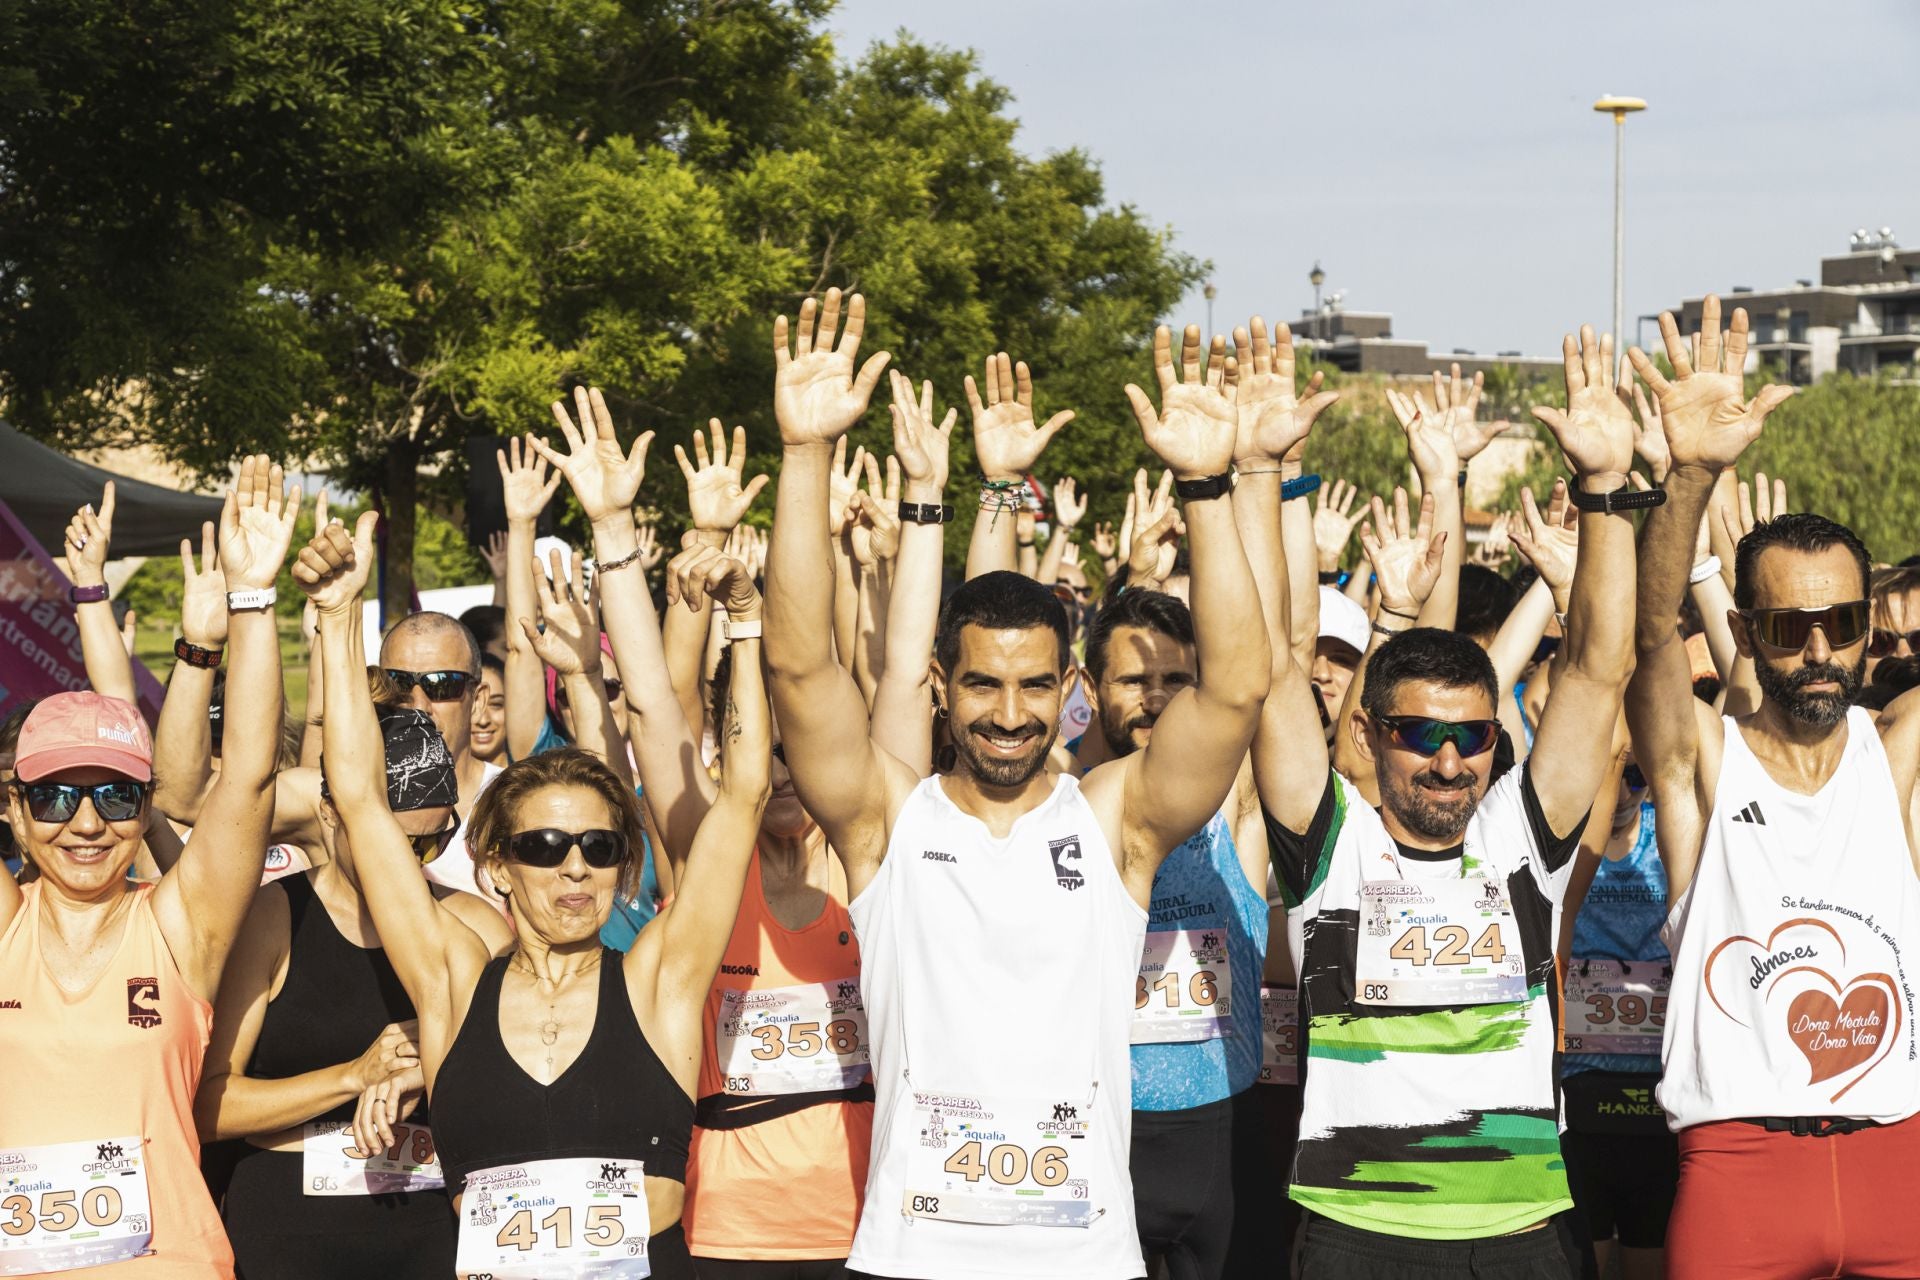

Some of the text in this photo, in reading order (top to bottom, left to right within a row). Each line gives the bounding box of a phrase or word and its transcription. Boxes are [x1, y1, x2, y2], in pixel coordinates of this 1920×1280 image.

[921, 850, 958, 864] JOSEKA
[1057, 877, 1085, 891] GYM
[1375, 885, 1423, 896] CARRERA
[1591, 884, 1660, 894] CAJA RURAL
[1385, 896, 1436, 905] DIVERSIDAD
[1781, 896, 1798, 908] Se
[1799, 897, 1834, 911] tardan
[1407, 911, 1448, 926] aqualia
[1834, 905, 1864, 921] menos
[1864, 914, 1874, 929] de
[1873, 925, 1882, 935] 5
[1390, 923, 1506, 966] 424
[721, 964, 760, 977] BEGOÑA
[1139, 962, 1165, 973] ualia
[1749, 945, 1819, 990] admo.es
[1364, 984, 1388, 1000] 5K
[1598, 981, 1630, 994] aqualia
[1903, 982, 1916, 1016] salvar
[1584, 993, 1667, 1027] 395
[127, 1016, 162, 1029] GYM
[763, 1013, 800, 1025] aqualia
[1792, 1014, 1831, 1034] Dona
[751, 1018, 860, 1061] 358
[1809, 1028, 1879, 1051] Dona Vida
[1909, 1039, 1917, 1061] vida
[728, 1077, 750, 1092] 5K
[930, 1094, 983, 1111] CARRERA
[1597, 1101, 1664, 1117] HANKE
[943, 1107, 995, 1121] DIVERSIDAD
[964, 1129, 1006, 1142] aqualia
[944, 1140, 1069, 1188] 406
[312, 1176, 338, 1192] 5K
[478, 1168, 527, 1185] CARRERA
[14, 1180, 52, 1194] aqualia
[1071, 1186, 1088, 1199] 01
[512, 1195, 555, 1210] aqualia
[912, 1194, 939, 1213] 5K
[1, 1185, 123, 1236] 350
[129, 1220, 149, 1233] 01
[496, 1204, 625, 1251] 415
